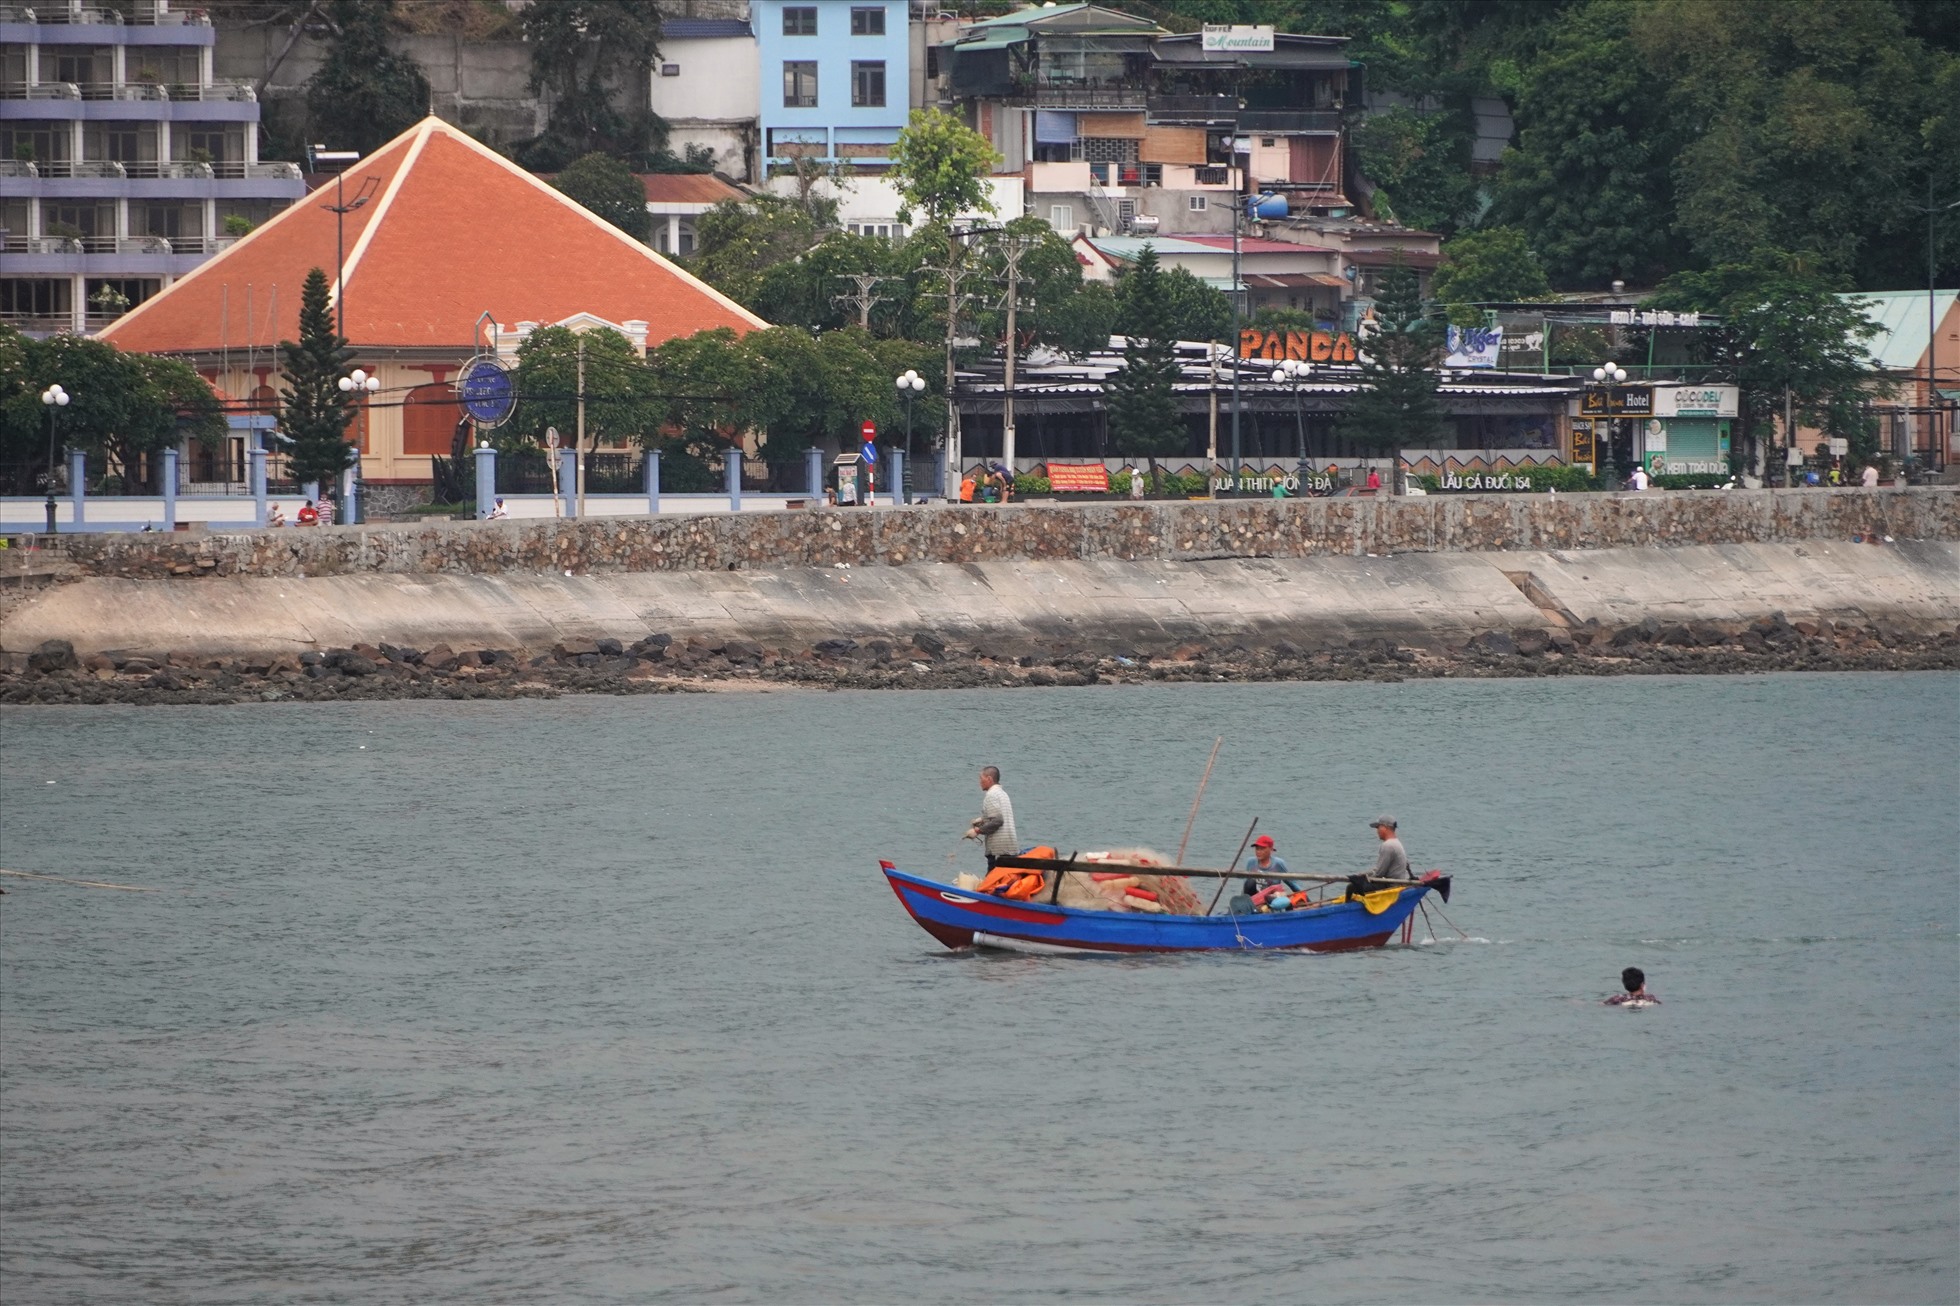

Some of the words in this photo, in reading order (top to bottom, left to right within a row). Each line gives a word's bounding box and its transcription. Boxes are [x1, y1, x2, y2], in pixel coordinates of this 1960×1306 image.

[1217, 35, 1270, 50] Mountain
[1463, 326, 1501, 353] Tiger
[1467, 355, 1495, 363] CRYSTAL
[1626, 393, 1649, 407] Hotel
[1465, 473, 1482, 489] CÁ
[1514, 476, 1530, 489] 154
